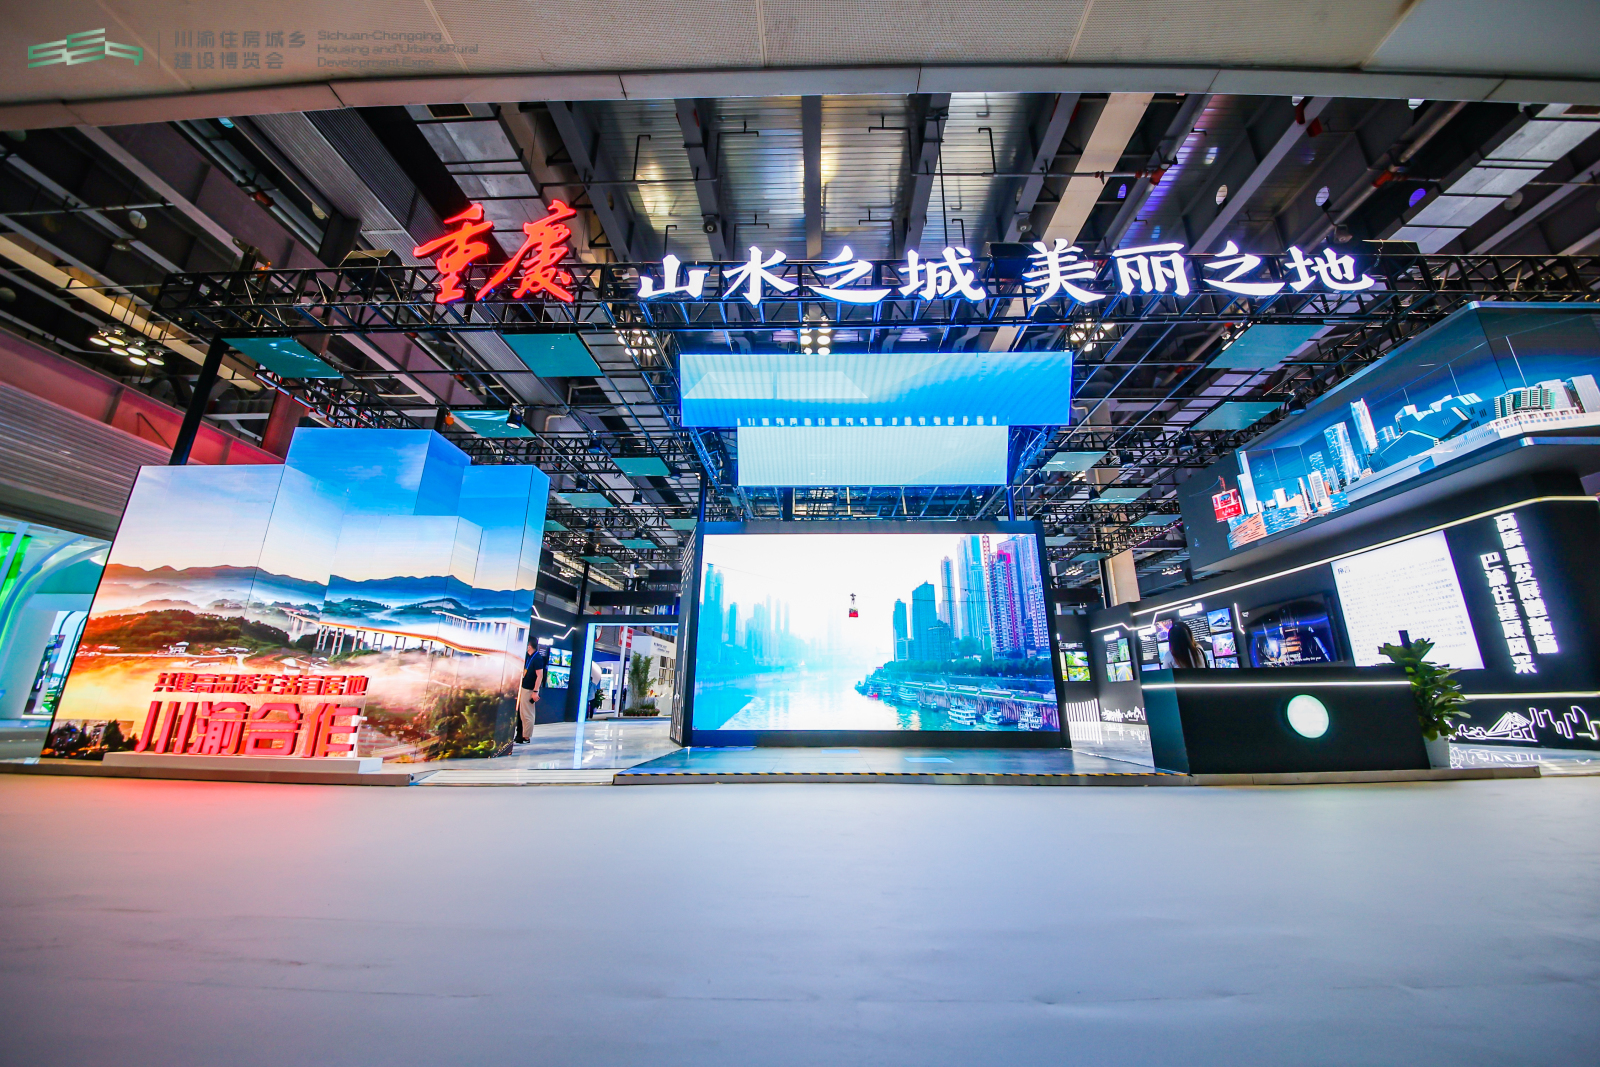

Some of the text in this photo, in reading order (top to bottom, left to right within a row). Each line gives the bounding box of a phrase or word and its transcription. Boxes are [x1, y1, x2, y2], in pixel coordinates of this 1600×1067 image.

[637, 245, 987, 306] 山水之城
[1022, 238, 1376, 306] 美丽之地
[153, 672, 370, 696] 共建高品质生活宜居地
[134, 701, 362, 758] 川渝合作
